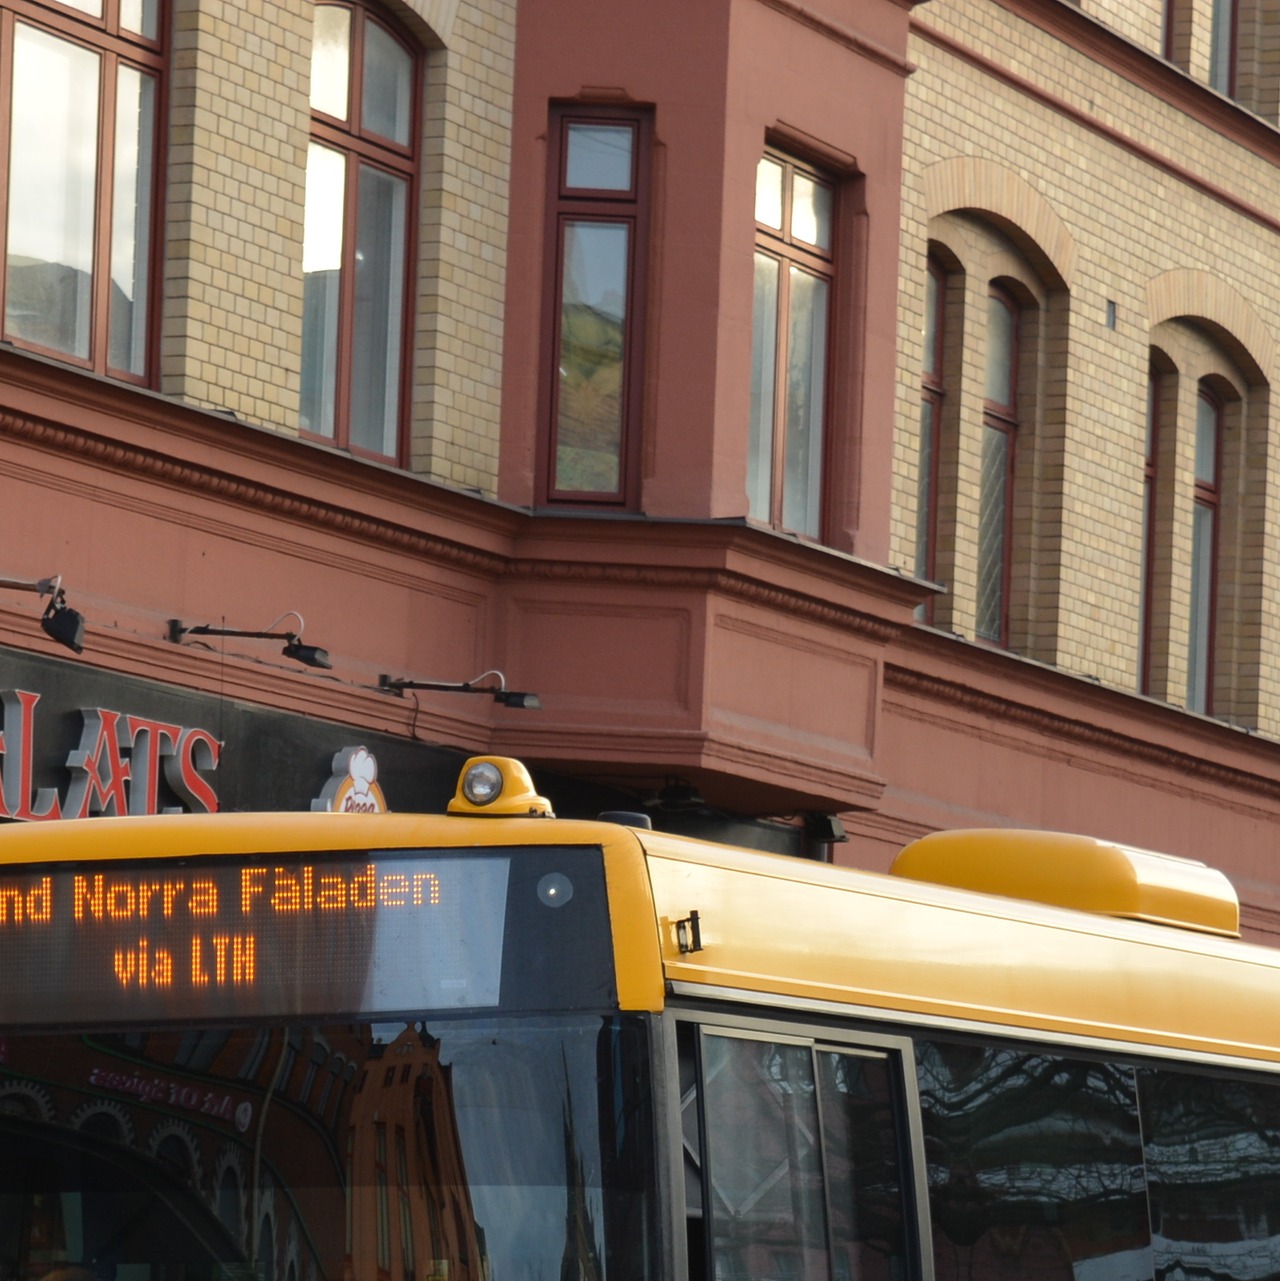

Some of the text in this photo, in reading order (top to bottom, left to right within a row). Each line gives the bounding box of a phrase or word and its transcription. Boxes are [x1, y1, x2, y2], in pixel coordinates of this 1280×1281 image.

[74, 874, 218, 919] Norra
[114, 935, 255, 986] via LTH
